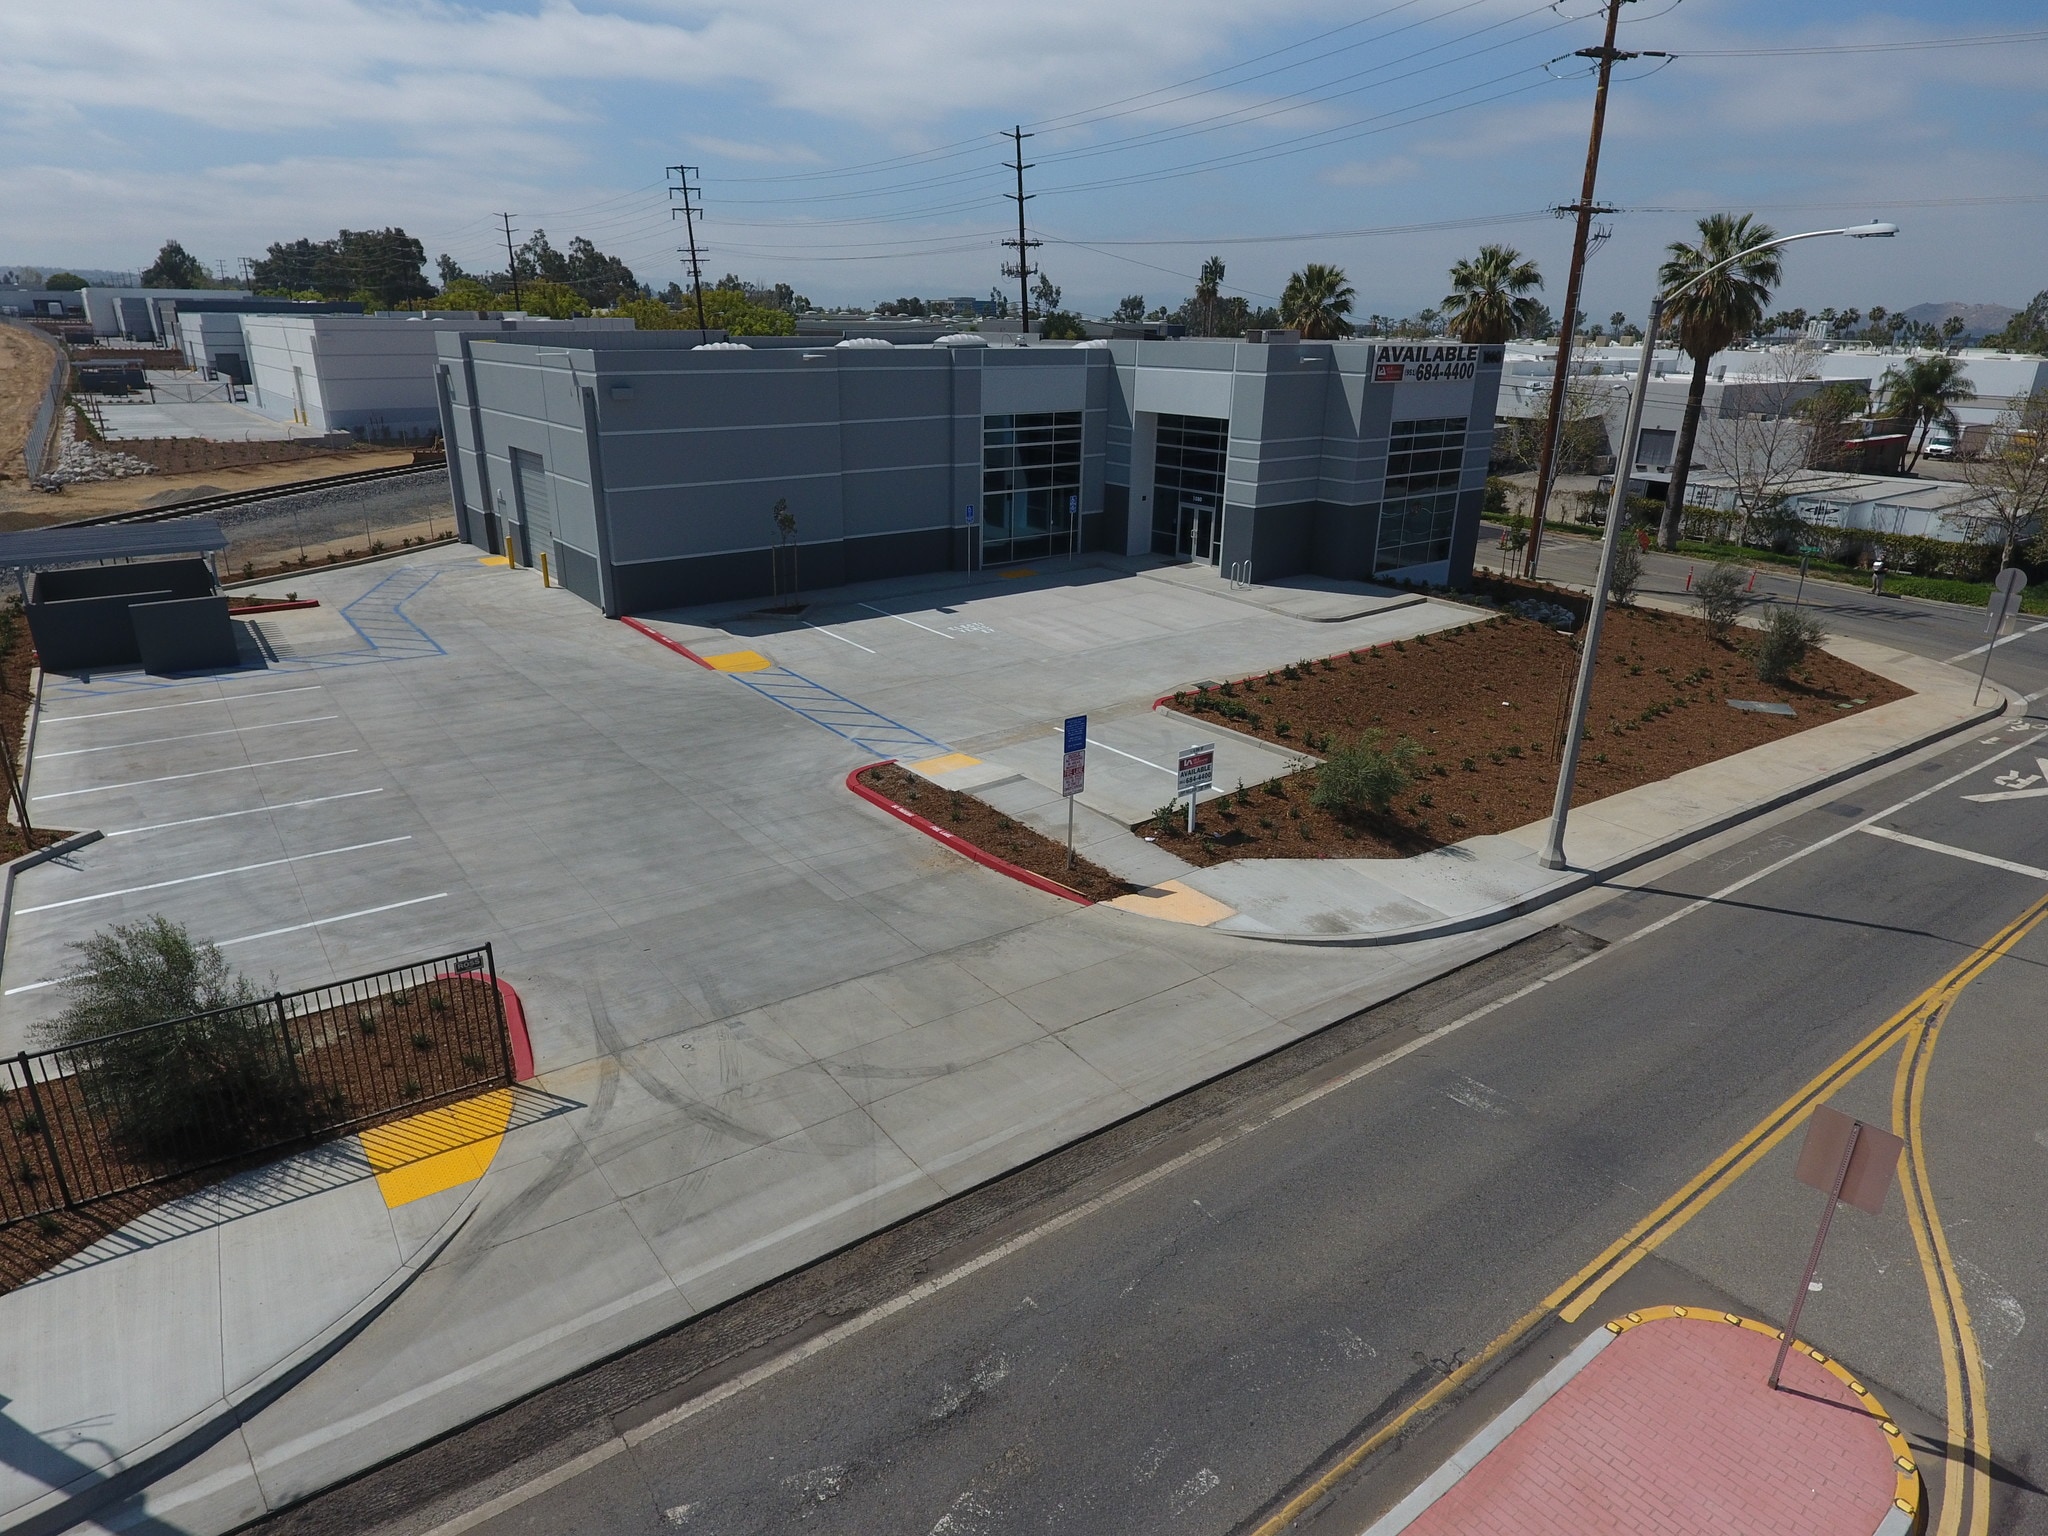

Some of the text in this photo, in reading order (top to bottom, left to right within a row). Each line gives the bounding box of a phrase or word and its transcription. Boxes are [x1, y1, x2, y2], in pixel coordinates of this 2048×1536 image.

[1377, 346, 1478, 362] AVAILABLE
[1416, 363, 1474, 381] 684-4400
[1180, 765, 1211, 778] AVAILABLE
[457, 958, 480, 970] ROSS
